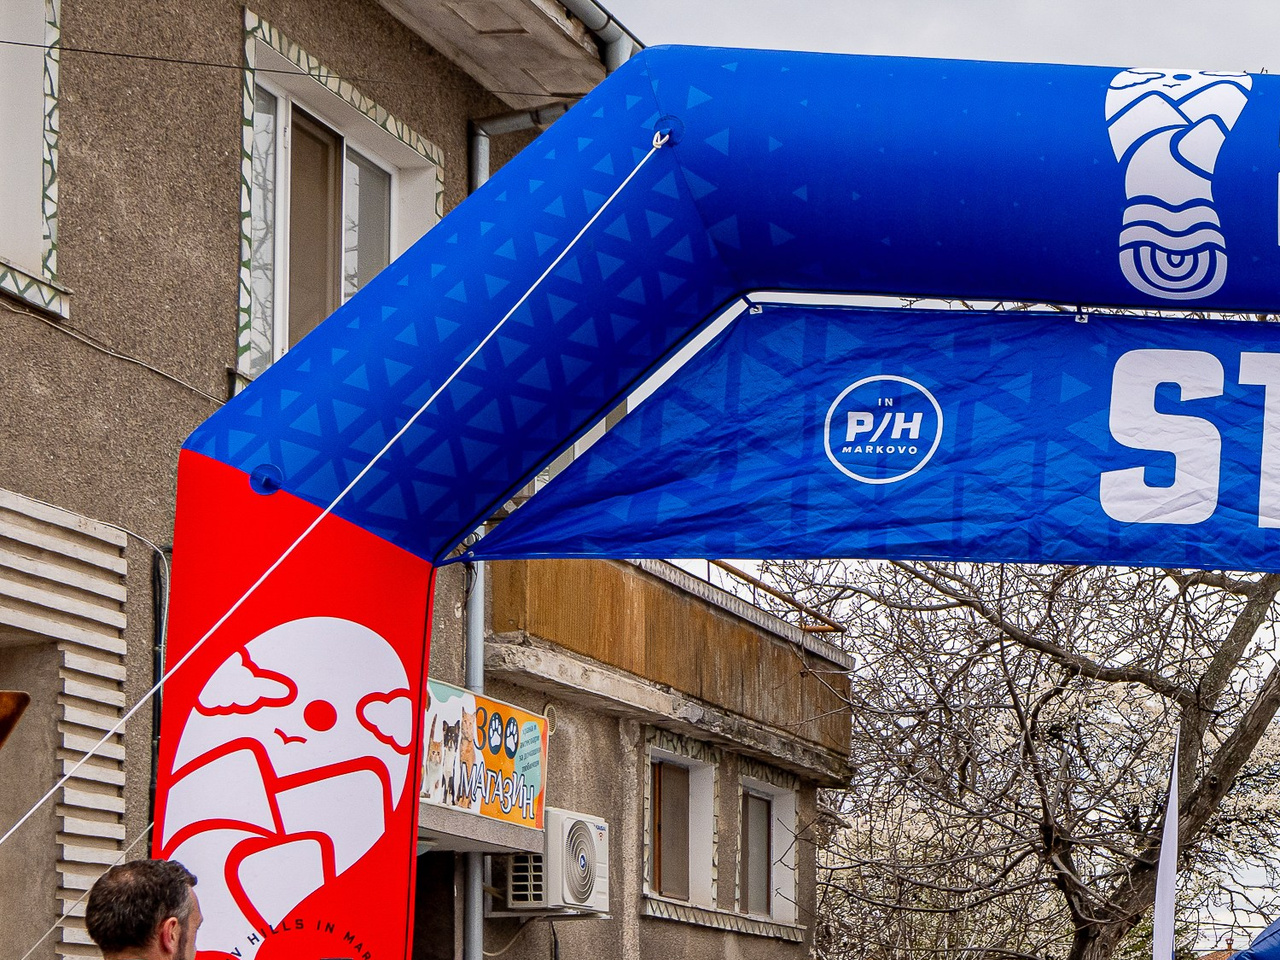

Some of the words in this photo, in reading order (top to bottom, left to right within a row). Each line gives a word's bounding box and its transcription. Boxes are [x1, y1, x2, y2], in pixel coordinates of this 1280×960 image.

[878, 397, 893, 407] IN
[845, 411, 923, 442] P/H
[842, 445, 918, 455] MARKOVO
[473, 706, 519, 759] ЗОО
[459, 761, 535, 820] МАГАЗИН
[247, 918, 304, 946] HILLS
[316, 920, 335, 934] IN
